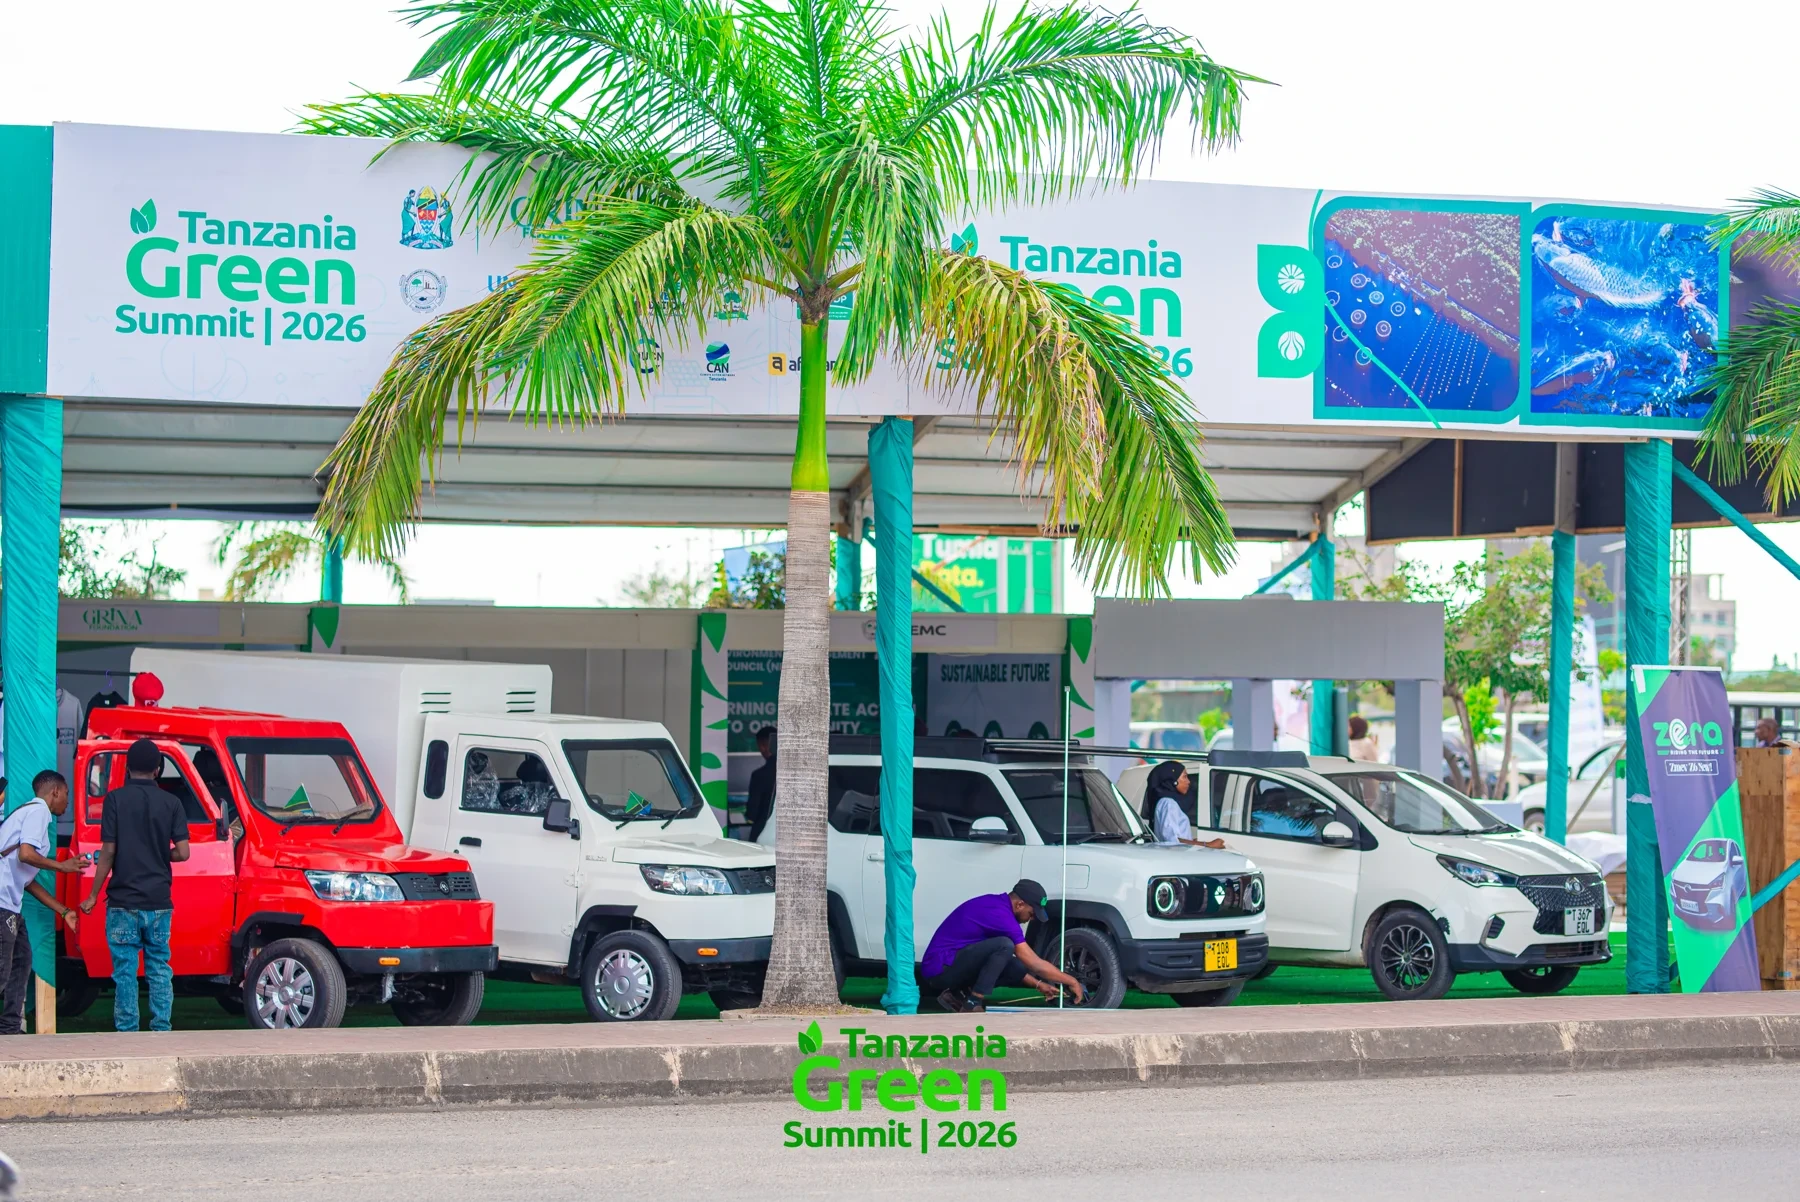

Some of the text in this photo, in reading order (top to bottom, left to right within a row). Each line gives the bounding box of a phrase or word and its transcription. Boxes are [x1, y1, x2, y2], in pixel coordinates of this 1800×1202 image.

[178, 211, 356, 250] Tanzania
[1000, 236, 1182, 279] Tanzania
[126, 237, 355, 306] Green
[116, 304, 254, 339] Summit
[282, 311, 367, 343] 2026
[706, 362, 729, 373] CAN
[912, 625, 946, 636] EMC
[728, 661, 765, 672] OUNCIL
[941, 663, 1050, 682] SUSTAINABLE FUTURE
[728, 702, 776, 716] RNING
